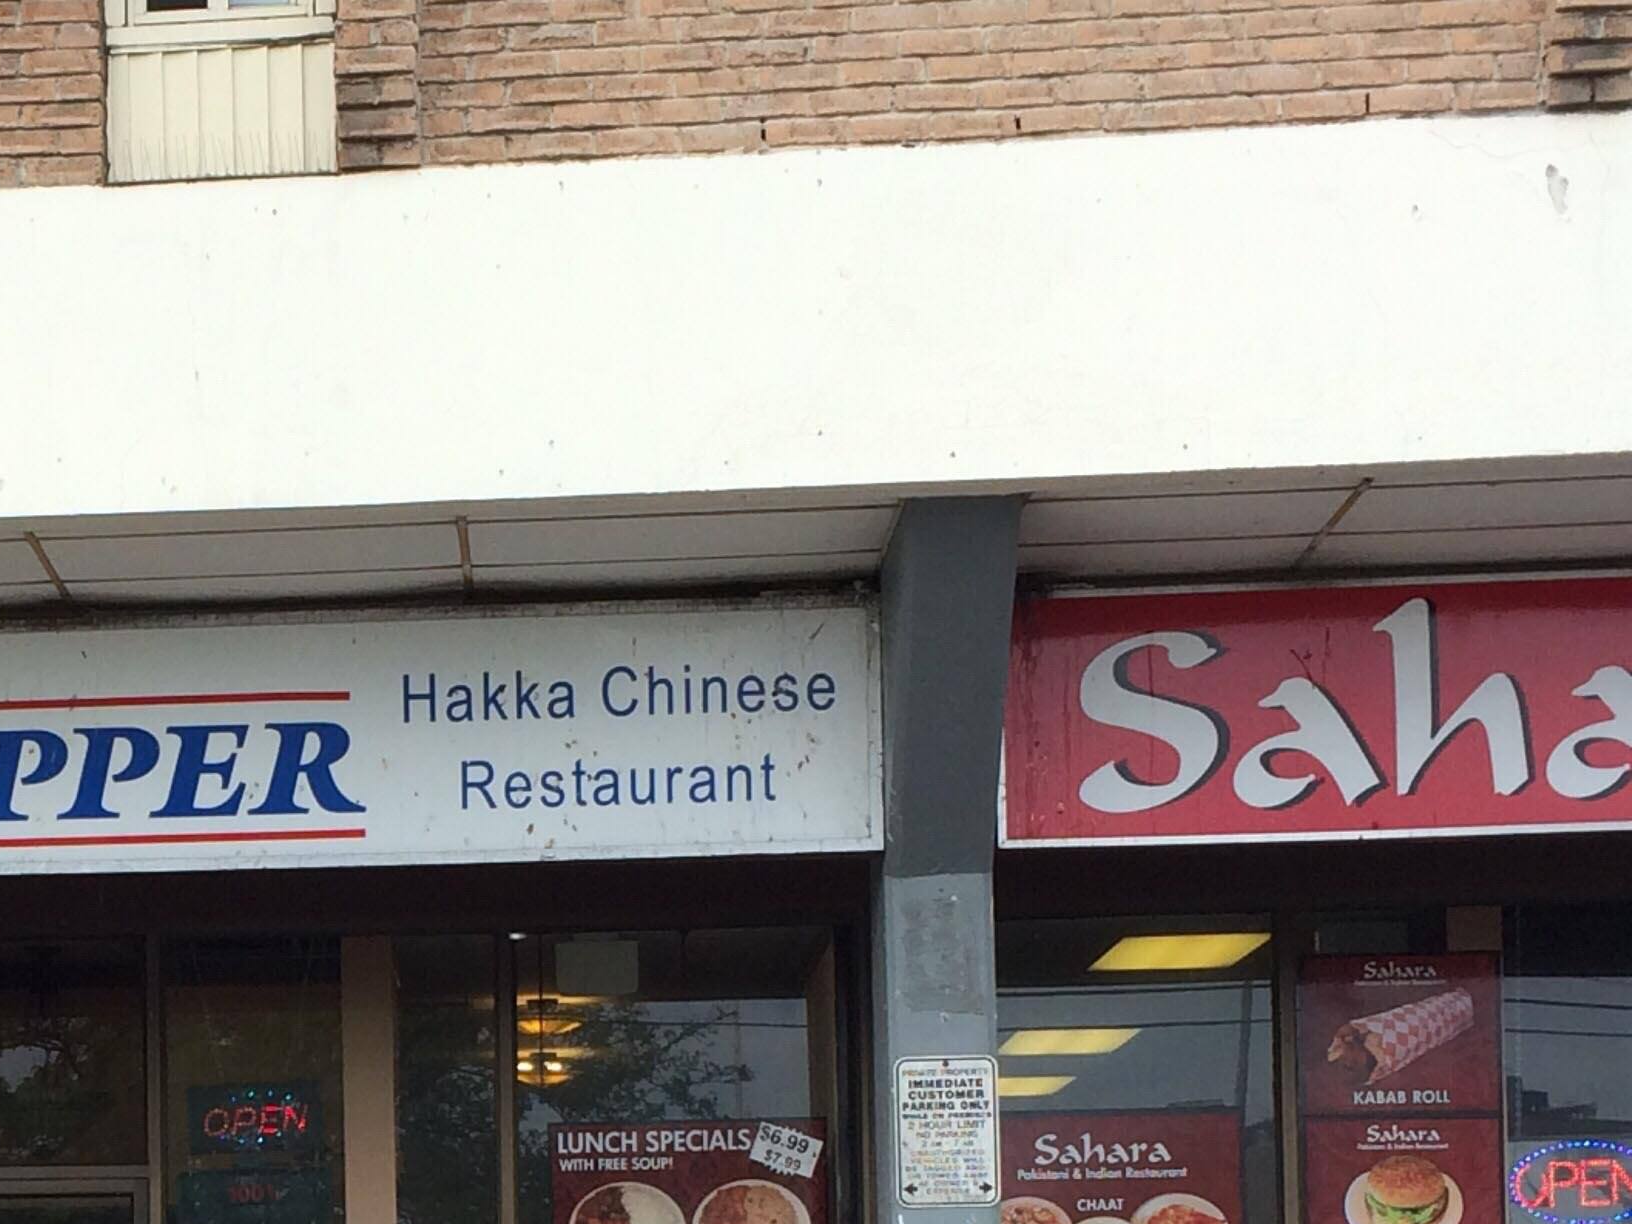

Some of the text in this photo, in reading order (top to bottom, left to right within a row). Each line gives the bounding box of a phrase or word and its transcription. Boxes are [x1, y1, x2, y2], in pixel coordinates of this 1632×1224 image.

[402, 664, 836, 723] Hakka Chinese
[461, 753, 776, 809] Restaurant
[1363, 961, 1437, 979] Sahara
[908, 1079, 983, 1088] IMMEDIATE
[908, 1089, 984, 1099] CUSTOMER
[1353, 1090, 1450, 1104] KABAB ROLL
[902, 1100, 989, 1110] PARKING ONLY
[203, 1104, 308, 1136] OPEN
[557, 1128, 752, 1154] LUNCH SPECIALS
[759, 1125, 809, 1153] $6.99
[1367, 1125, 1440, 1142] Sahara
[1034, 1132, 1172, 1165] Sahara
[559, 1158, 594, 1171] WITH
[598, 1158, 628, 1171] FREE
[1077, 1198, 1124, 1212] CHAAT
